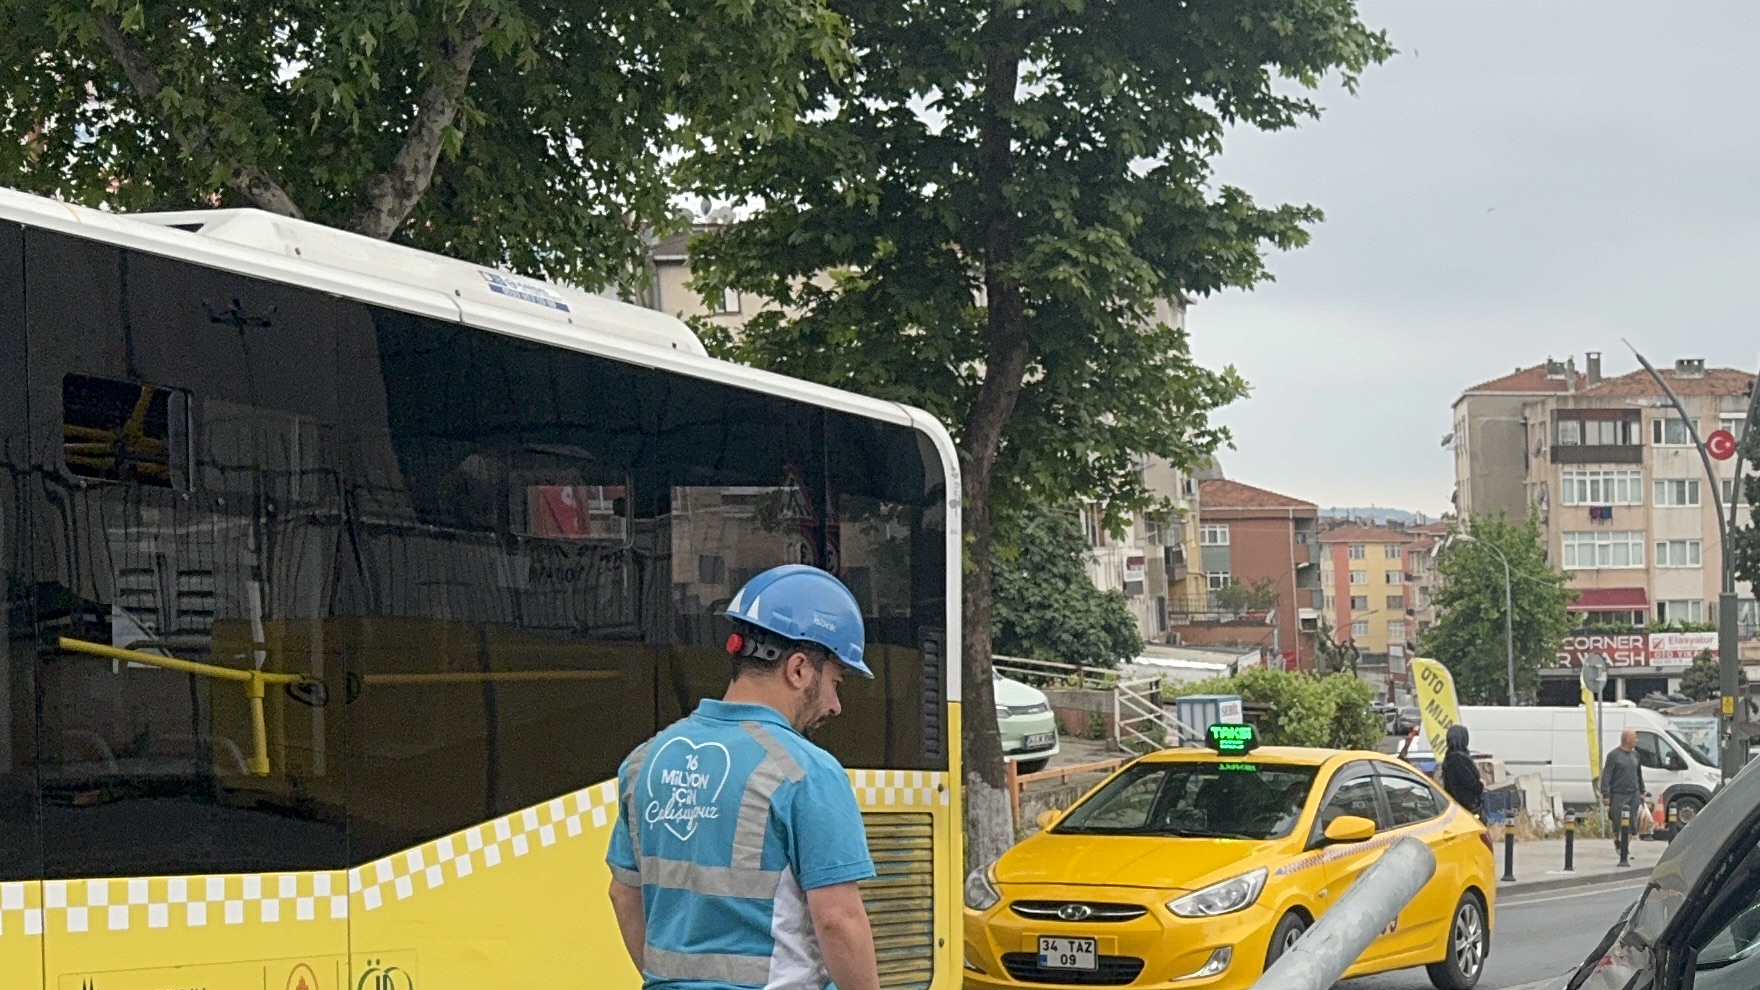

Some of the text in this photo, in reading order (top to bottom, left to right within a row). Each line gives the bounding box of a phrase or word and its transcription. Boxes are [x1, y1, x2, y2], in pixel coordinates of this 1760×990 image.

[1562, 635, 1643, 650] CORNER
[685, 754, 699, 771] 16
[1042, 940, 1092, 953] 34 TAZ
[1060, 953, 1077, 966] 09
